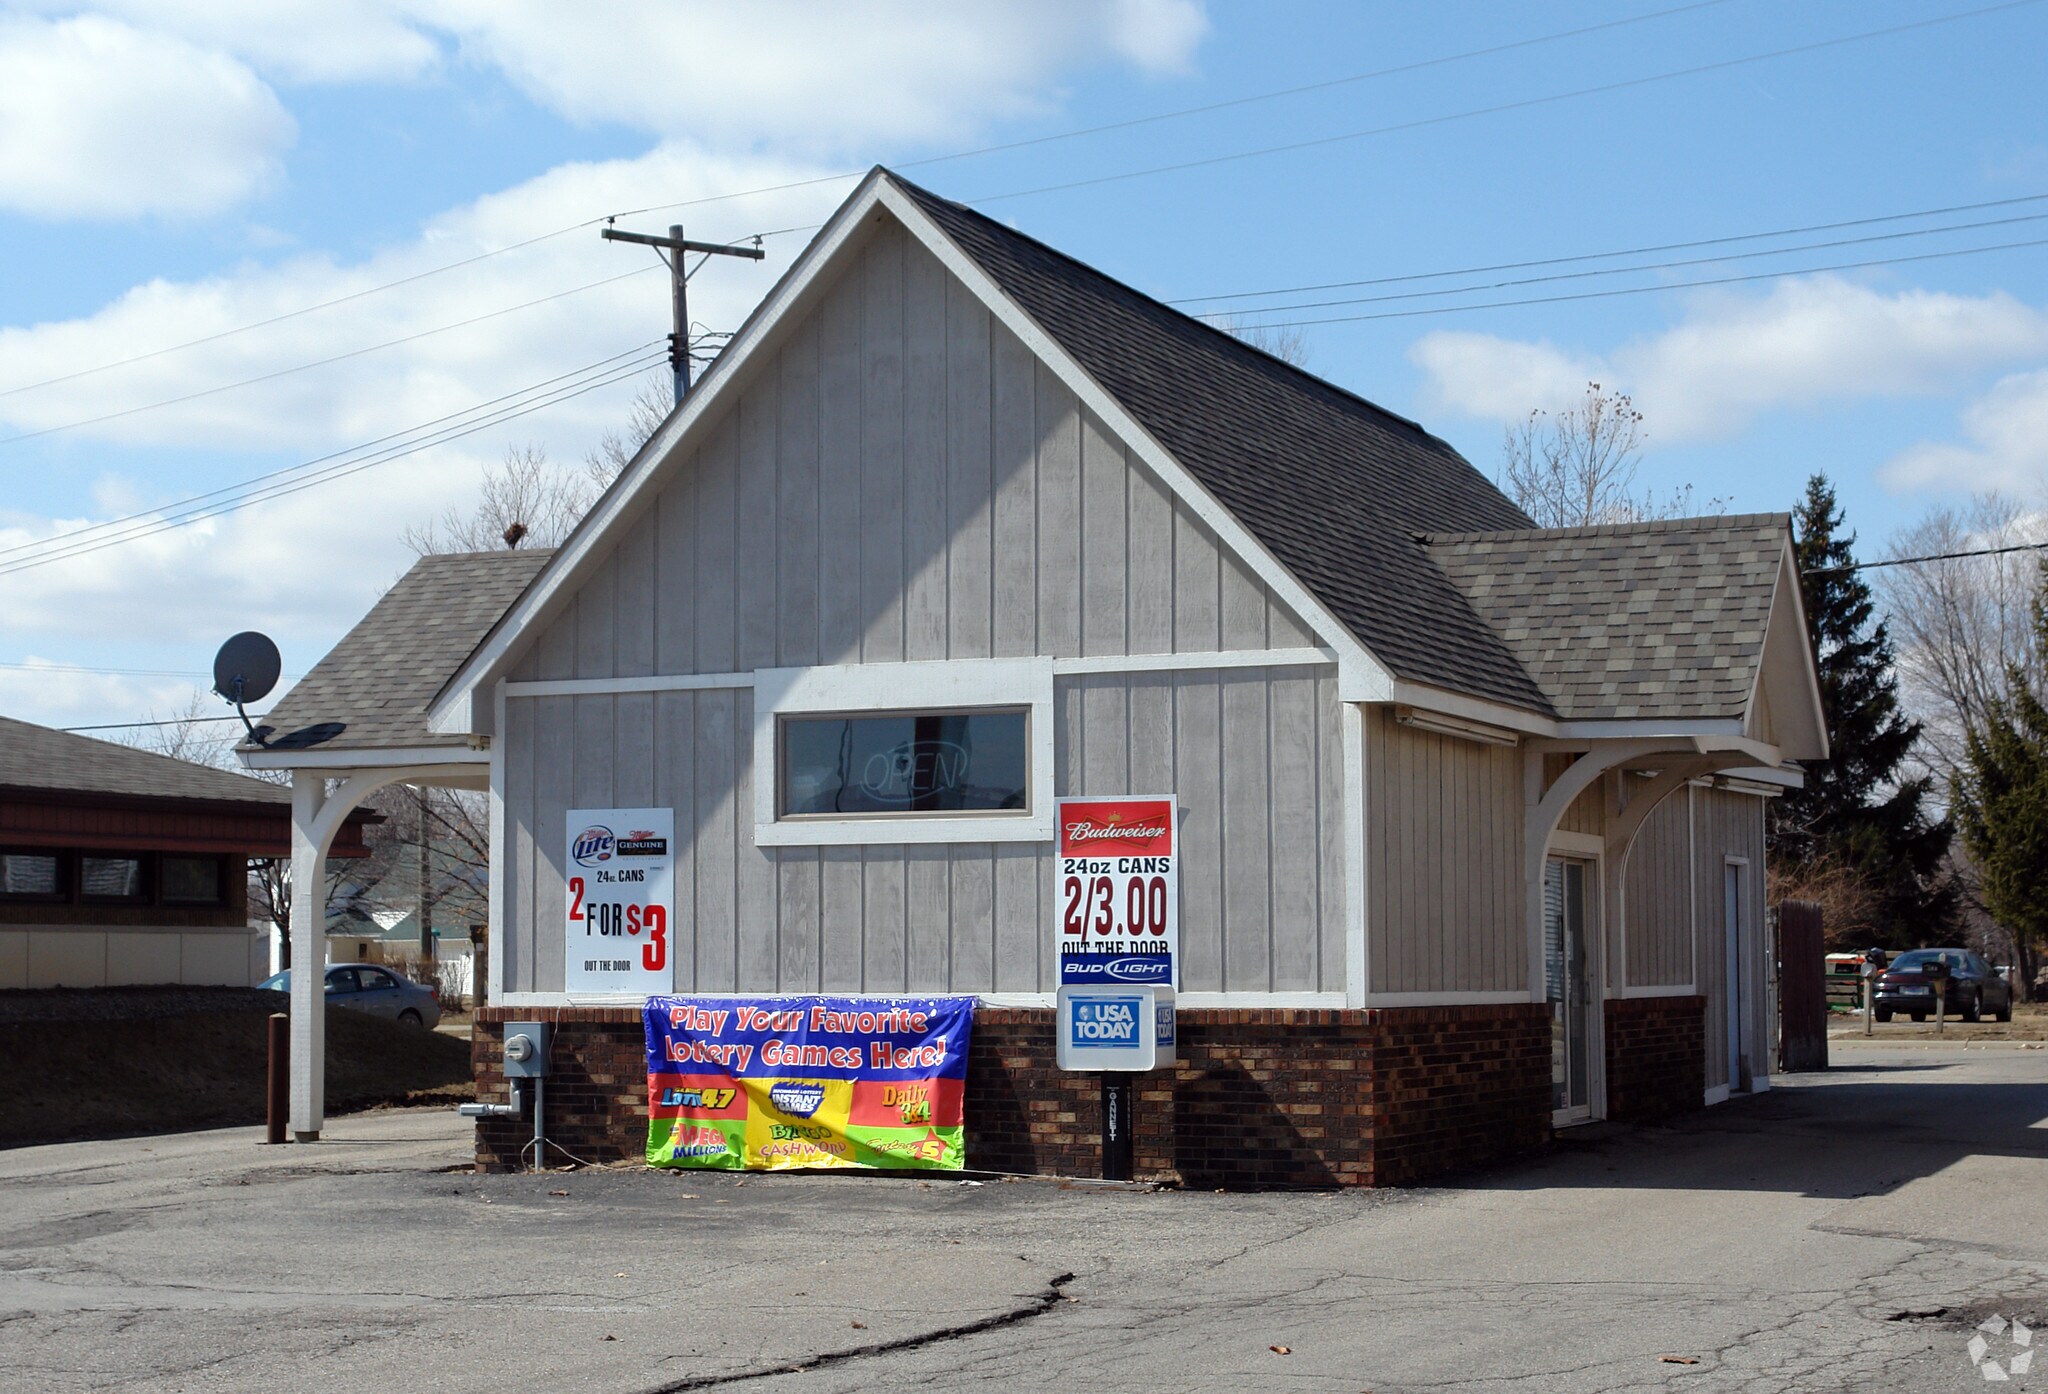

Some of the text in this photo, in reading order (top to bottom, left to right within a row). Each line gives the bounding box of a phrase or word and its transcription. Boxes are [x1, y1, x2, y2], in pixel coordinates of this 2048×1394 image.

[863, 753, 961, 791] OPEN
[1065, 821, 1166, 841] Budweiser
[576, 836, 614, 860] Lite
[619, 841, 664, 849] GENUINE
[1064, 857, 1170, 875] 24oz CANS
[618, 869, 645, 882] CANS
[569, 876, 585, 921] 2
[586, 903, 622, 936] FOR
[1063, 876, 1167, 943] 2/3.00
[1062, 940, 1169, 956] OUT THE DOOR
[584, 960, 631, 972] OUT THE DOOR
[1064, 963, 1169, 973] BUD LIGHT
[669, 1005, 930, 1037] Play Your Favorite
[1095, 1004, 1133, 1022] USA
[1075, 1021, 1136, 1039] TODAY
[664, 1033, 946, 1072] Lottery Games Here!
[701, 1087, 736, 1109] 47
[772, 1093, 821, 1105] INSTANT
[881, 1084, 928, 1107] Daily
[780, 1102, 815, 1113] GAMES
[674, 1122, 728, 1147] MEGA
[769, 1123, 832, 1141] BINGO
[672, 1144, 728, 1160] MILLIONS
[920, 1141, 940, 1158] 5
